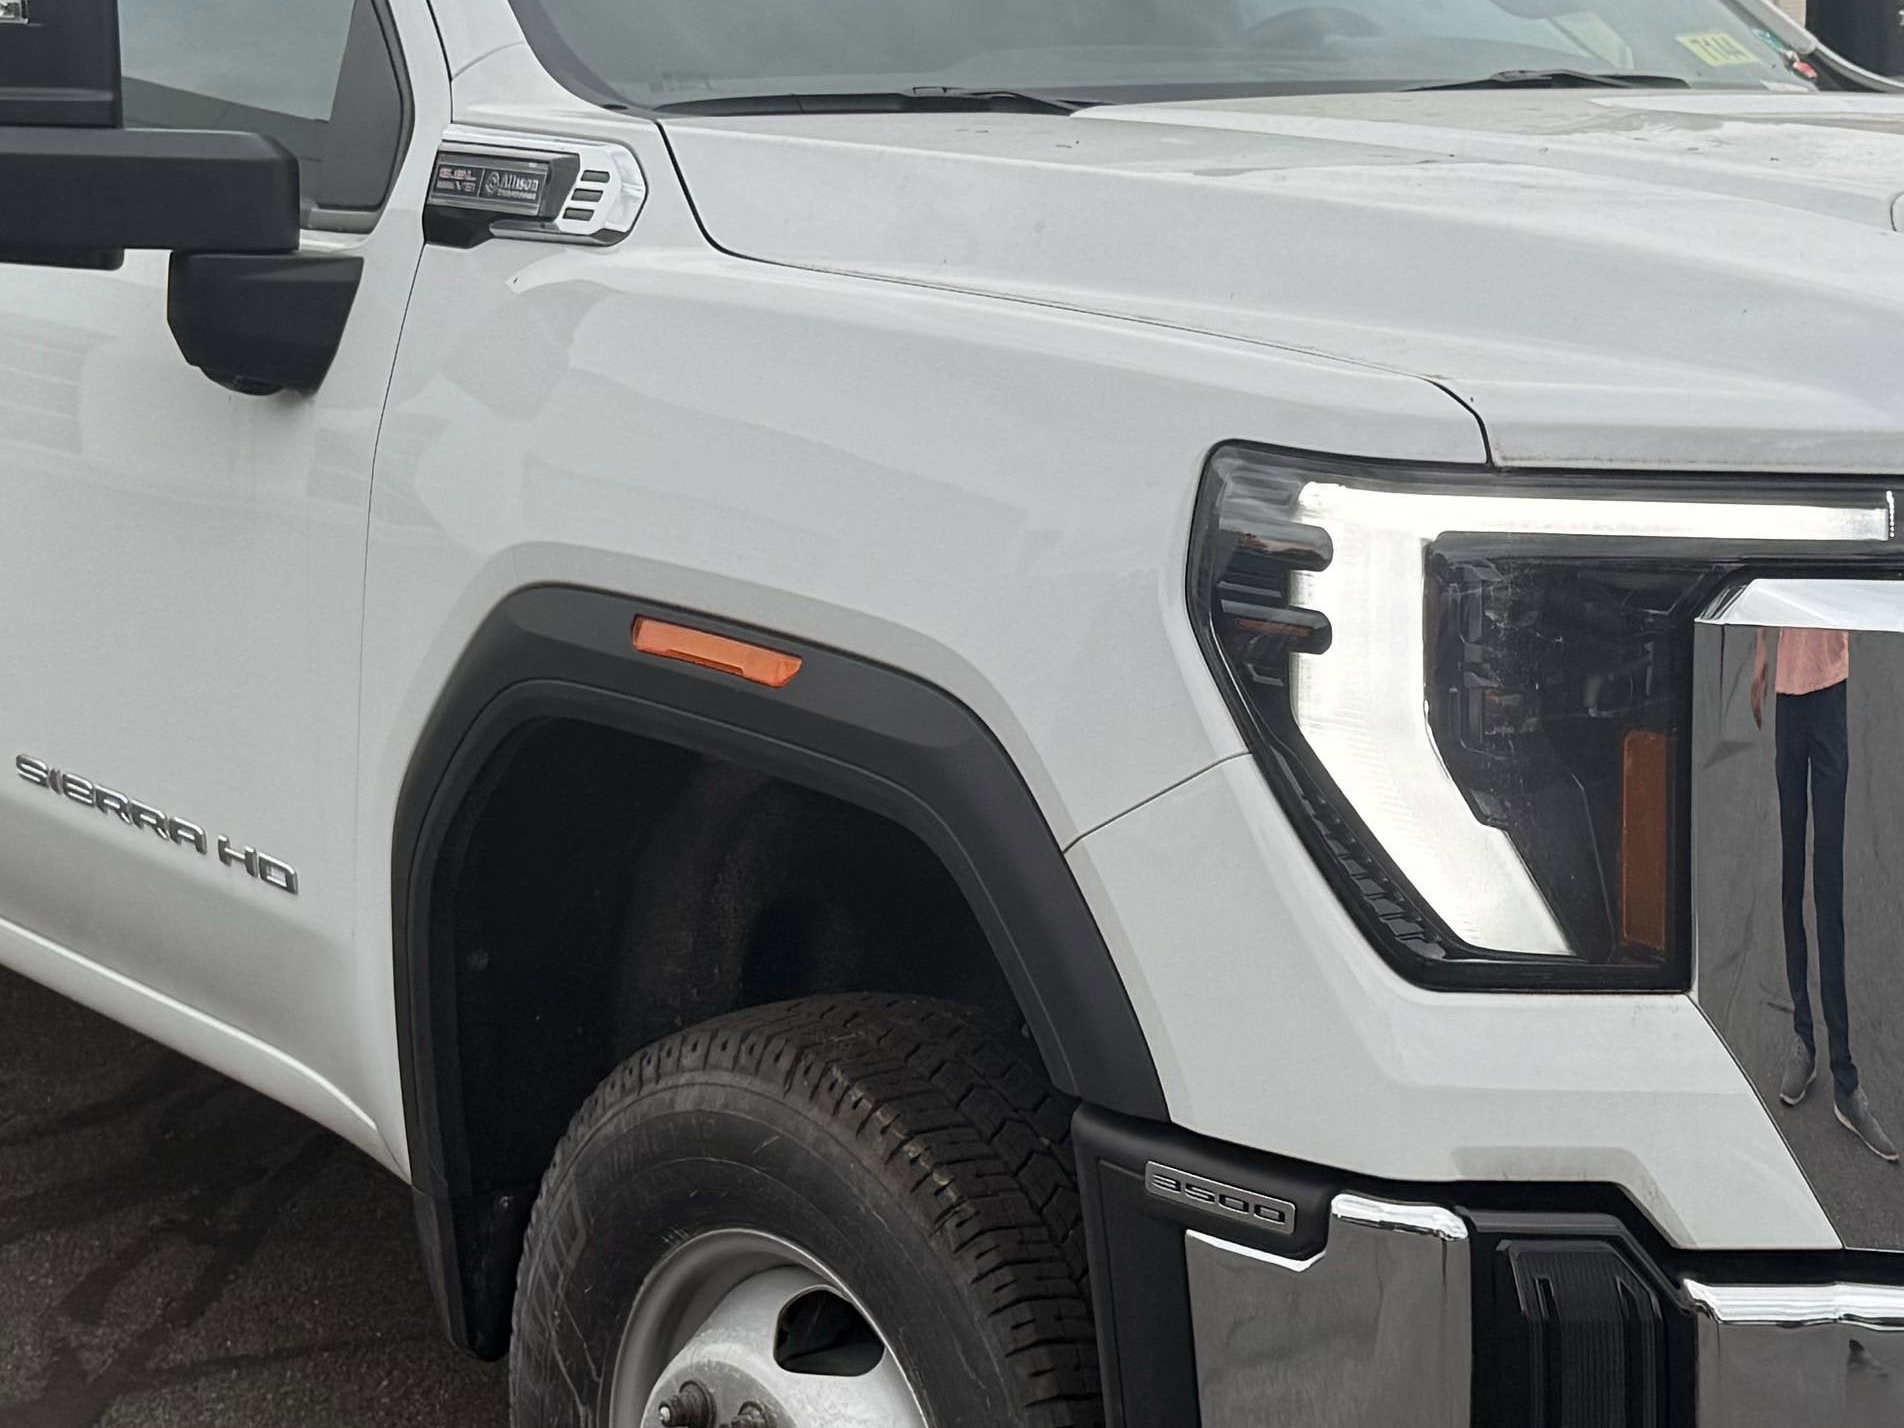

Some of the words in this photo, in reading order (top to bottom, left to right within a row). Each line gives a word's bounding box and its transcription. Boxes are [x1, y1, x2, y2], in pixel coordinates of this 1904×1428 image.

[500, 173, 539, 192] Allison
[15, 753, 207, 855] SIERRA
[217, 833, 299, 895] HD
[1151, 1173, 1286, 1226] 3500
